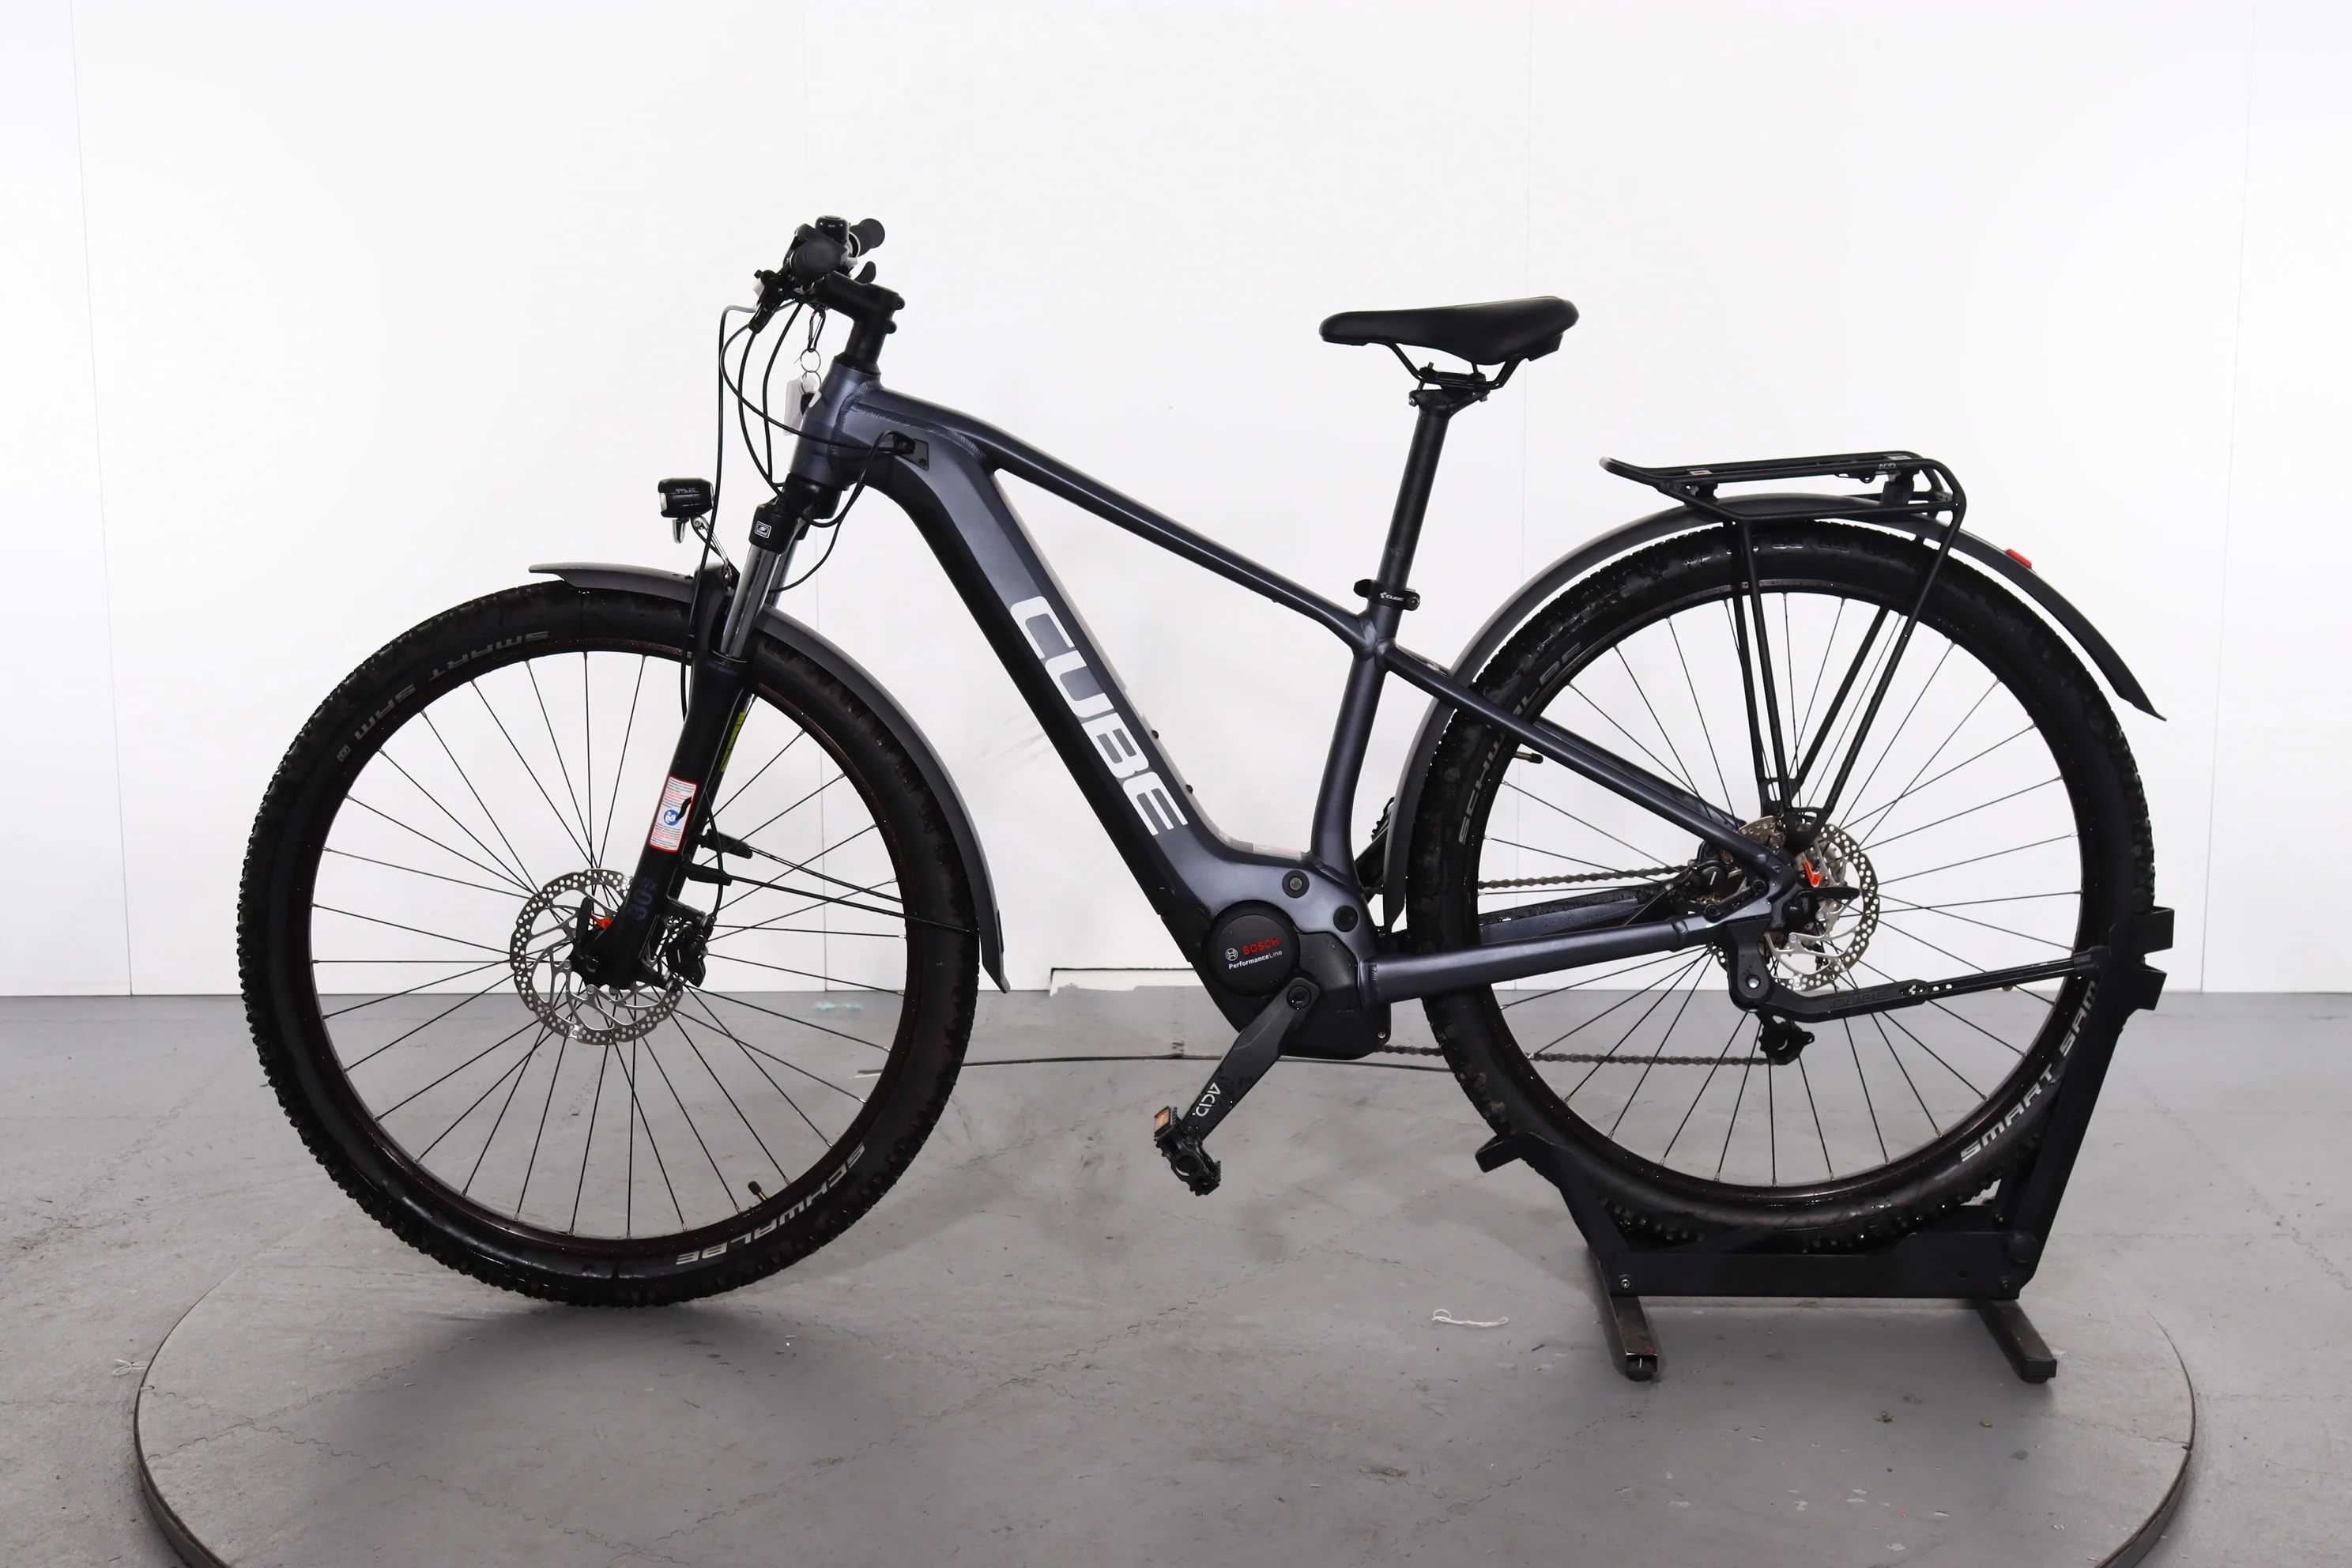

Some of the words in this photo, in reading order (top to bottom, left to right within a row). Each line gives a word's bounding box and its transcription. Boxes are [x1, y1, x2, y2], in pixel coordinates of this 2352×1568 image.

[428, 631, 548, 682] SMART
[355, 684, 416, 740] SAM
[1010, 596, 1189, 835] CUBE
[1242, 937, 1280, 956] BOSCH
[1830, 991, 1888, 1009] CUBE
[1961, 1063, 2052, 1162] SMART
[2060, 980, 2096, 1057] SAM
[676, 1142, 865, 1265] SCHWALBE
